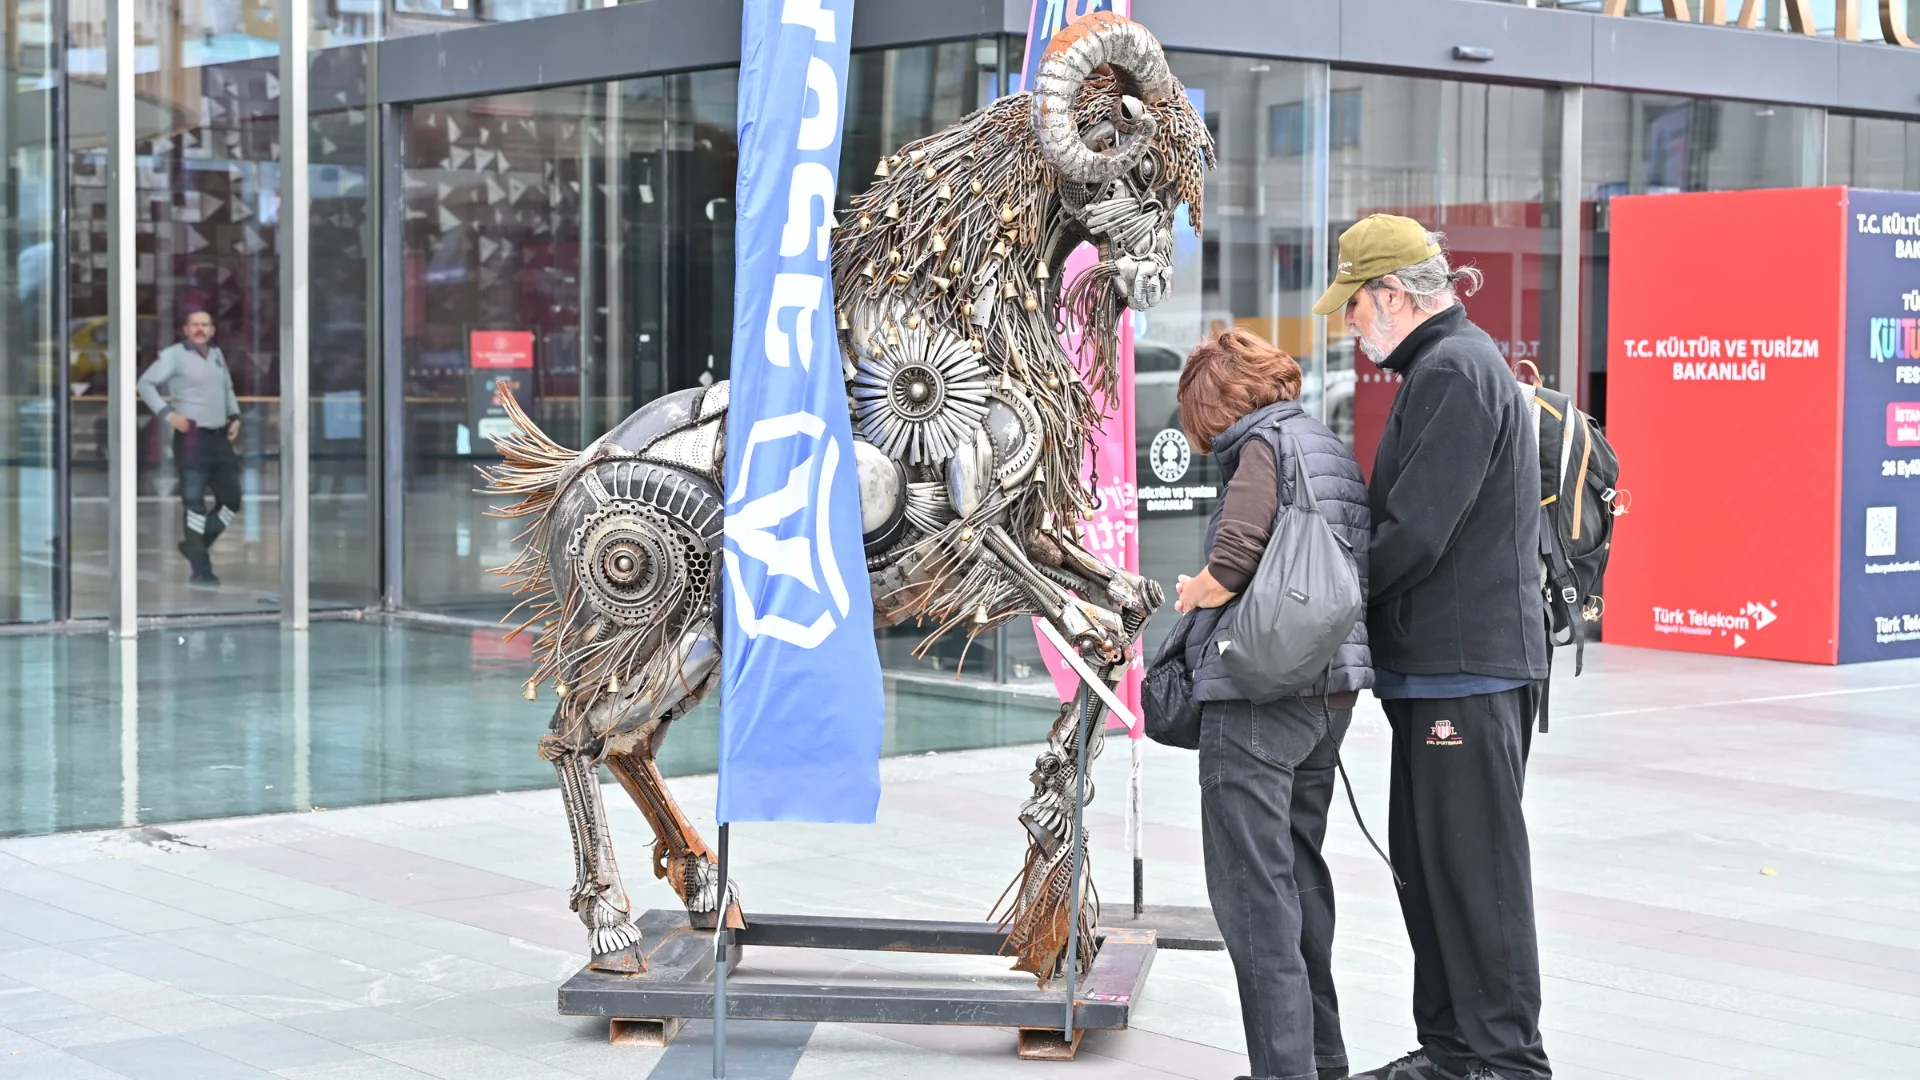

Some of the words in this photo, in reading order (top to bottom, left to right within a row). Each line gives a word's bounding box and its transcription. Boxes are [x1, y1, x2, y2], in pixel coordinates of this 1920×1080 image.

[1856, 213, 1880, 234] T.C.
[1624, 339, 1653, 358] T.C.
[1656, 336, 1721, 358] KÜLTÜR
[1724, 339, 1747, 358] VE
[1750, 336, 1819, 358] TURİZM
[1673, 359, 1766, 380] BAKANLIĞI
[1652, 606, 1685, 624] Türk
[1687, 609, 1749, 630] Telekom
[1875, 615, 1900, 634] Türk
